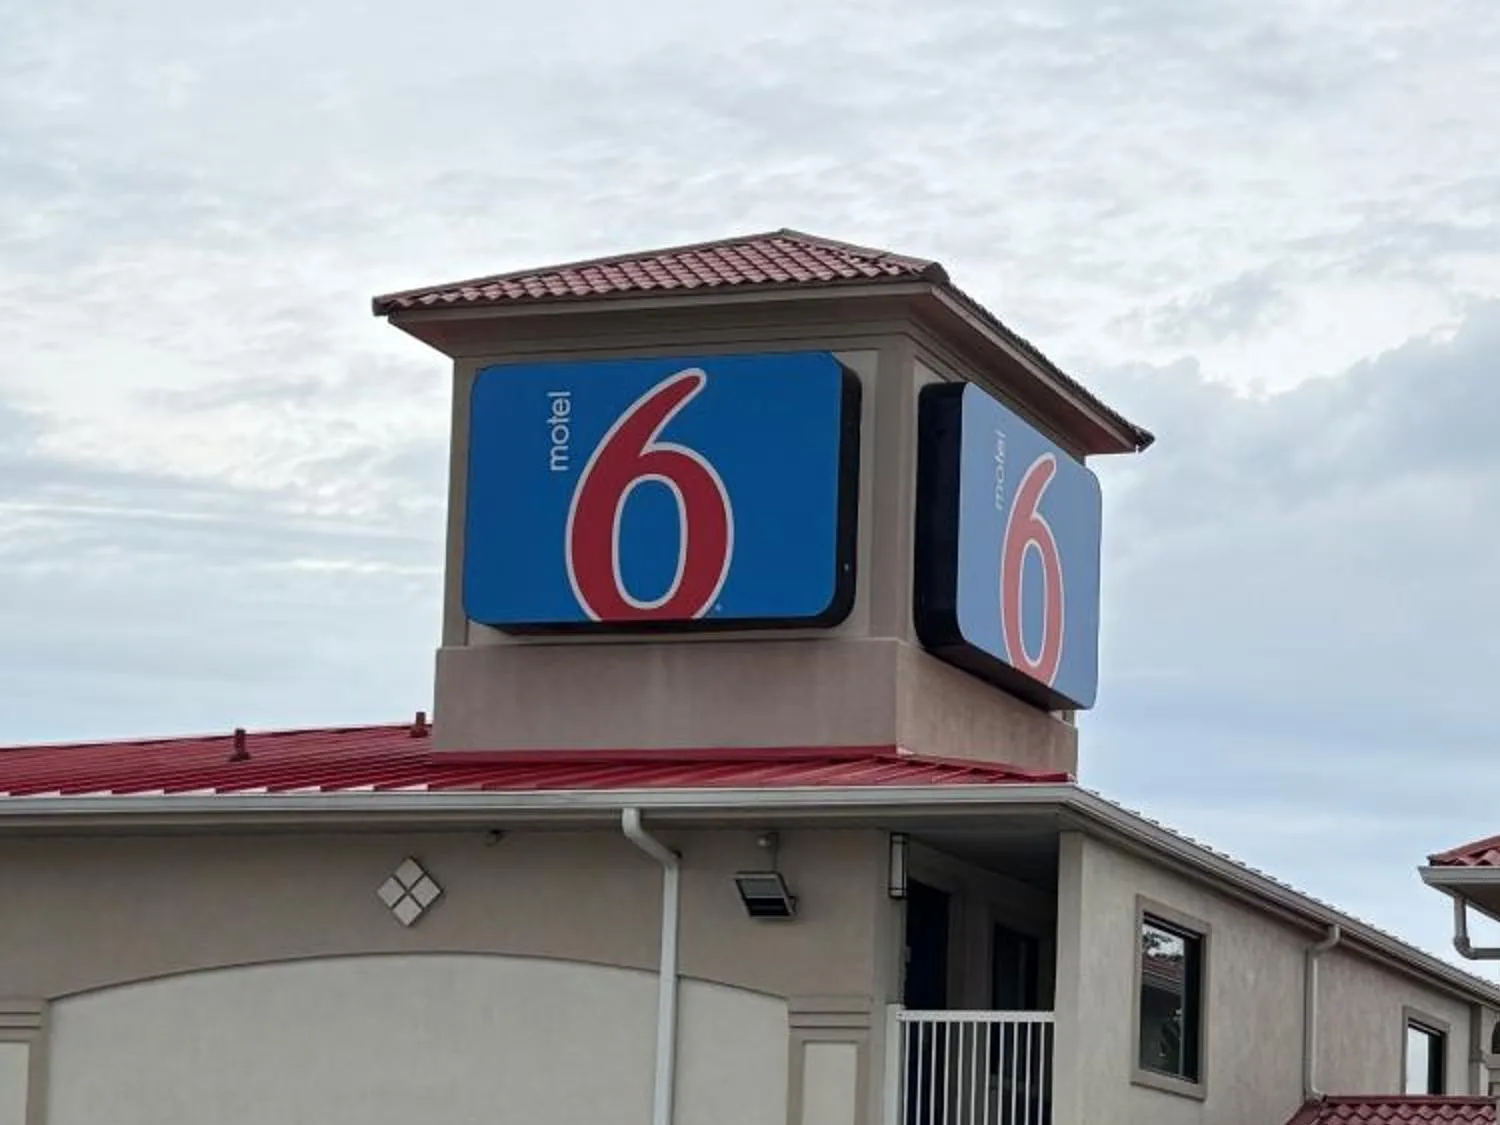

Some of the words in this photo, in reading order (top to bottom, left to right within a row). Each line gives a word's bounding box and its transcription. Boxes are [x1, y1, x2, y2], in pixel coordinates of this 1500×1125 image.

[546, 391, 571, 471] motel
[565, 367, 734, 620] 6
[1000, 452, 1064, 687] 6
